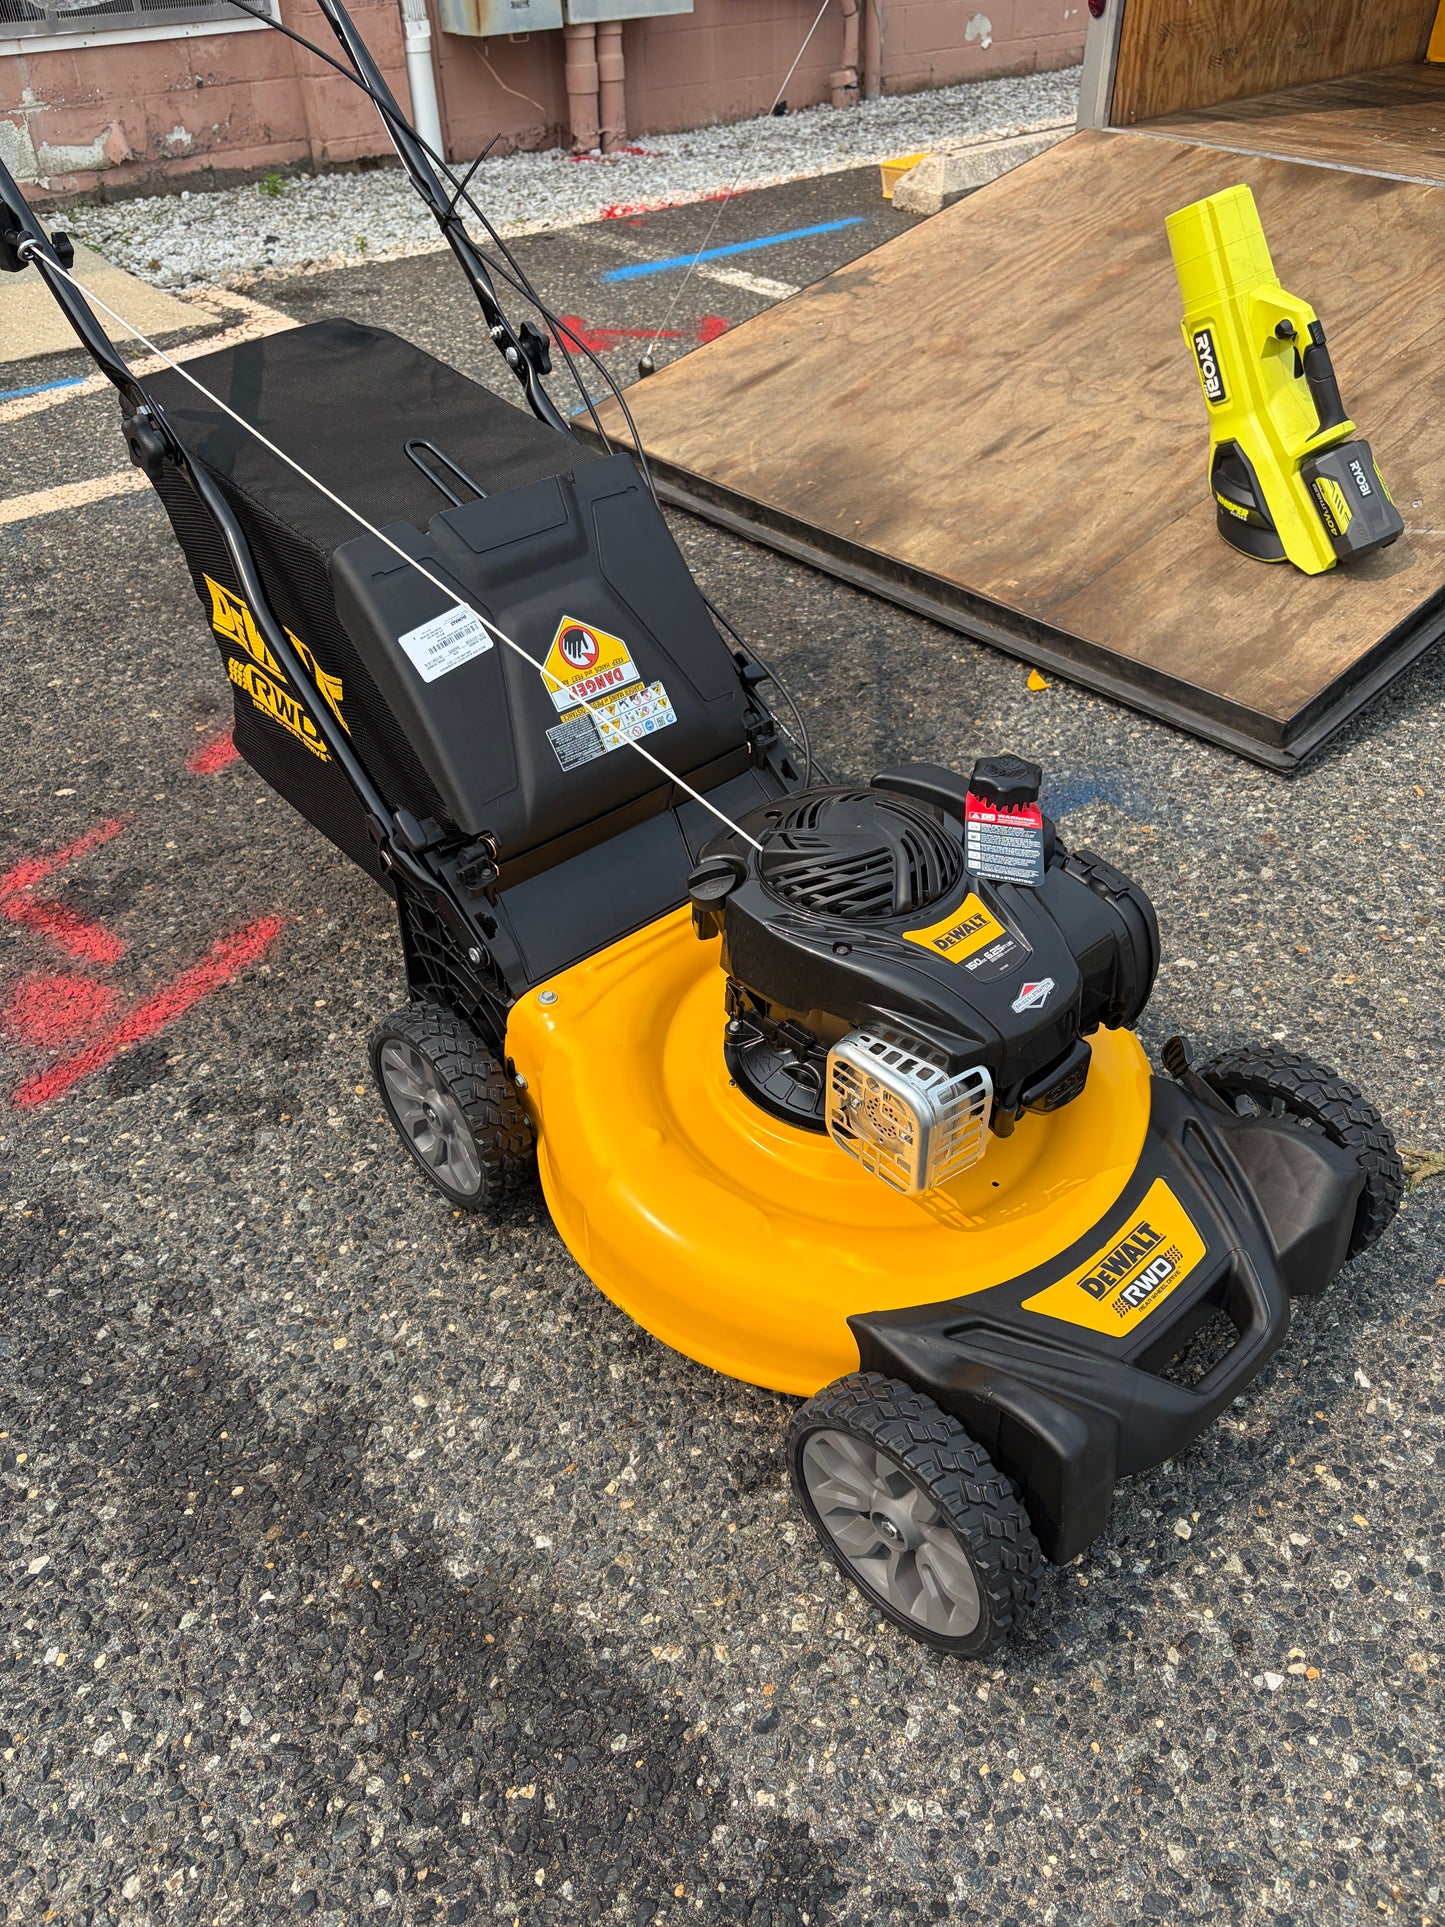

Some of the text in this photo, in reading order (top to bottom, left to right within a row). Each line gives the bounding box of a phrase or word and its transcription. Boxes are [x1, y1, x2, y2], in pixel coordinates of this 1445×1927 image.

[1195, 333, 1221, 399] RYOBI
[1349, 460, 1372, 496] RYOBI
[1216, 494, 1249, 518] WHISPER
[571, 673, 584, 683] FEET
[594, 662, 611, 674] HANDS
[252, 673, 325, 748] RWD
[997, 813, 1036, 823] WARNING
[1122, 1256, 1173, 1305] RWD
[1151, 1283, 1168, 1299] WHEEL
[1166, 1269, 1181, 1285] DRIVE
